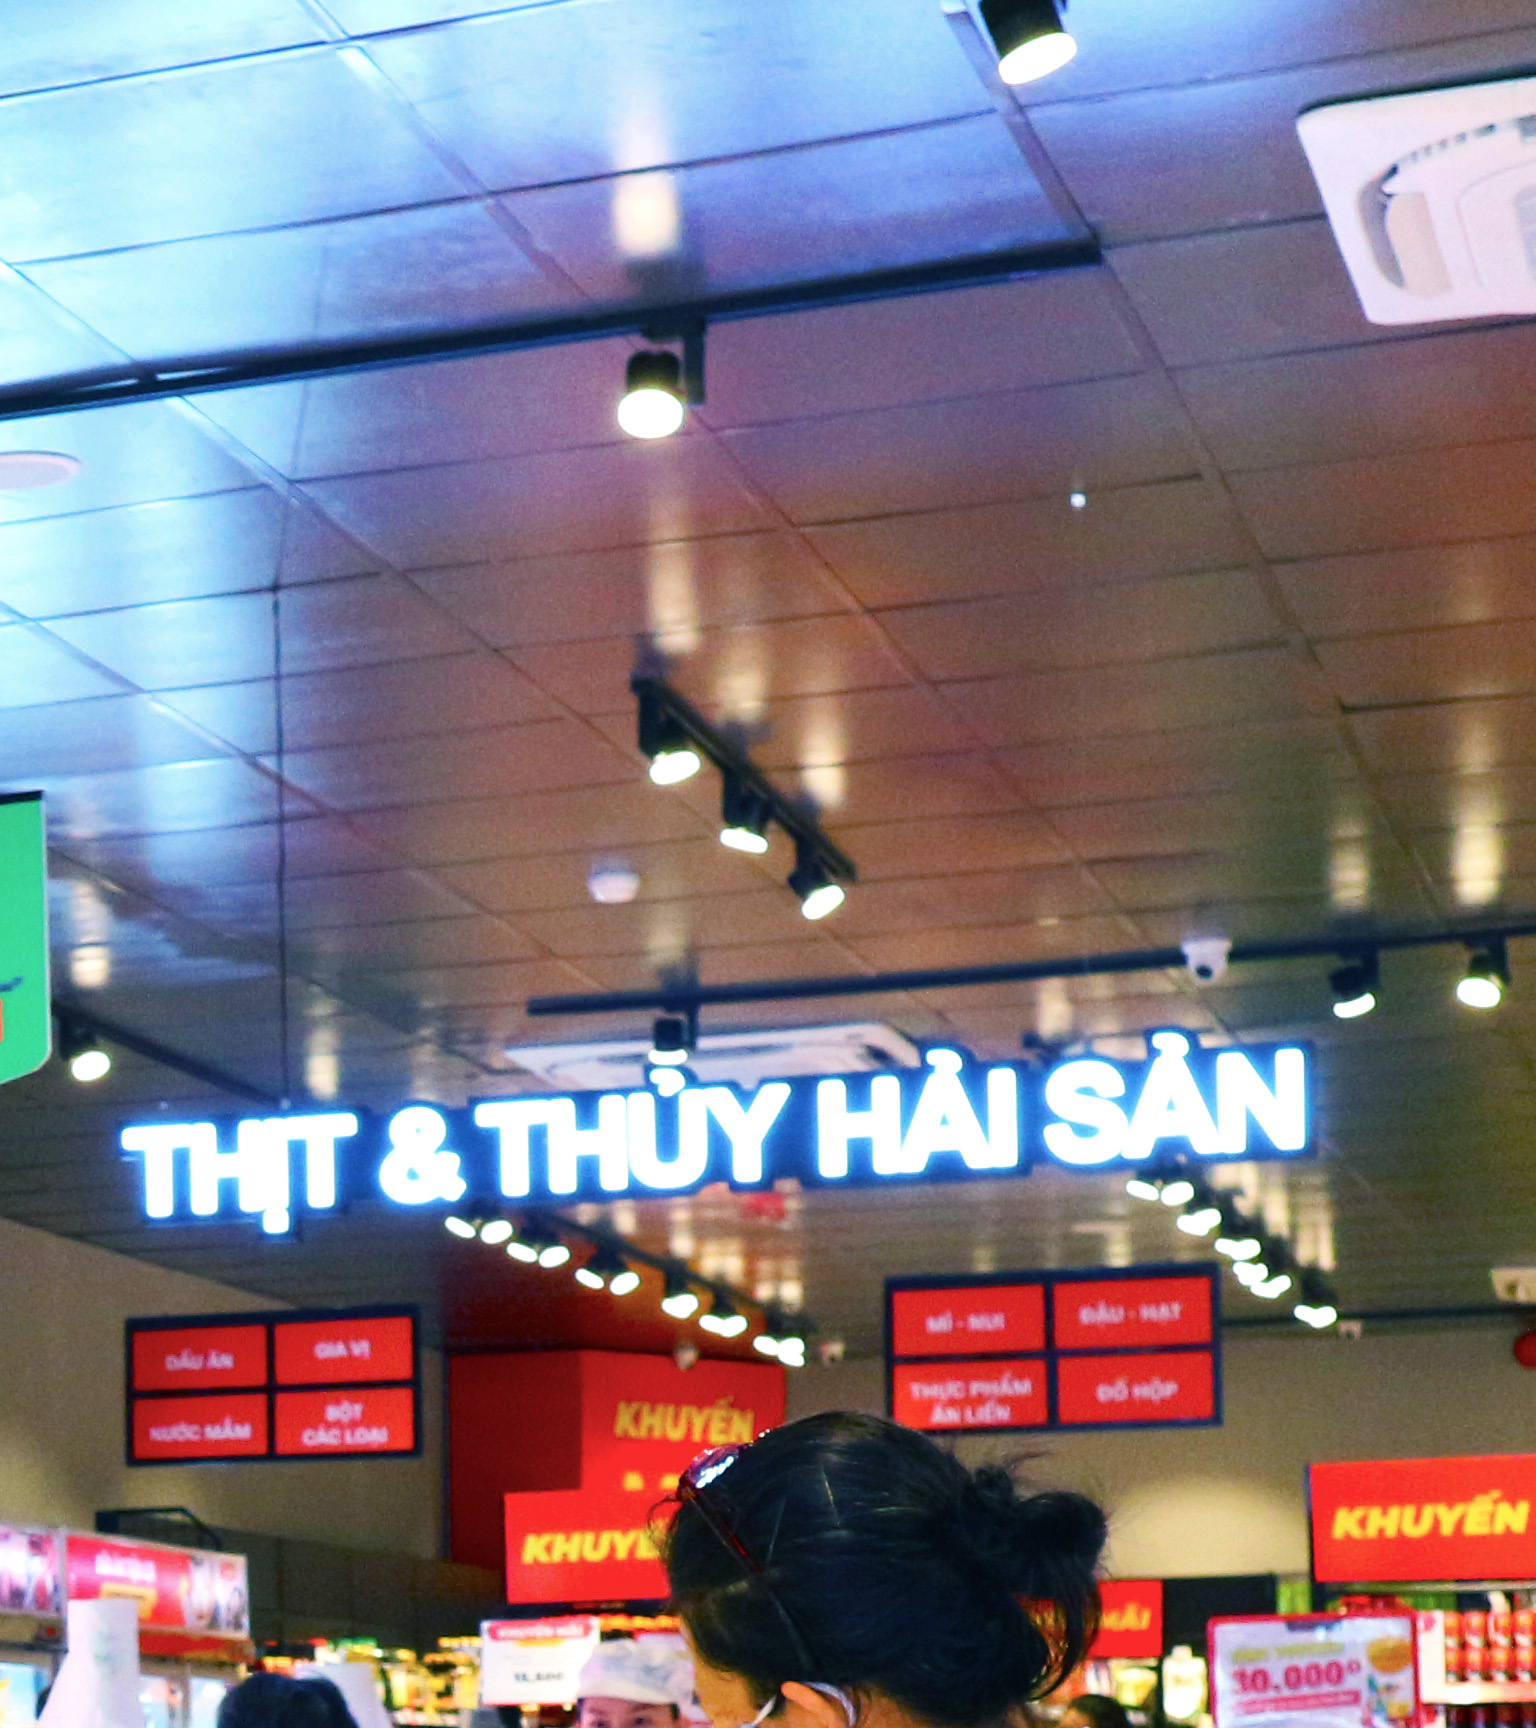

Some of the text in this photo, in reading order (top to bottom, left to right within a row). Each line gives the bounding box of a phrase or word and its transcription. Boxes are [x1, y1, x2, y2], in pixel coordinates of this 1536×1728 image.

[120, 1028, 1308, 1236] THỊT & THỦY HẢI SẢN
[614, 1395, 755, 1445] KHUYẾN
[1332, 1490, 1531, 1541] KHUYẾN
